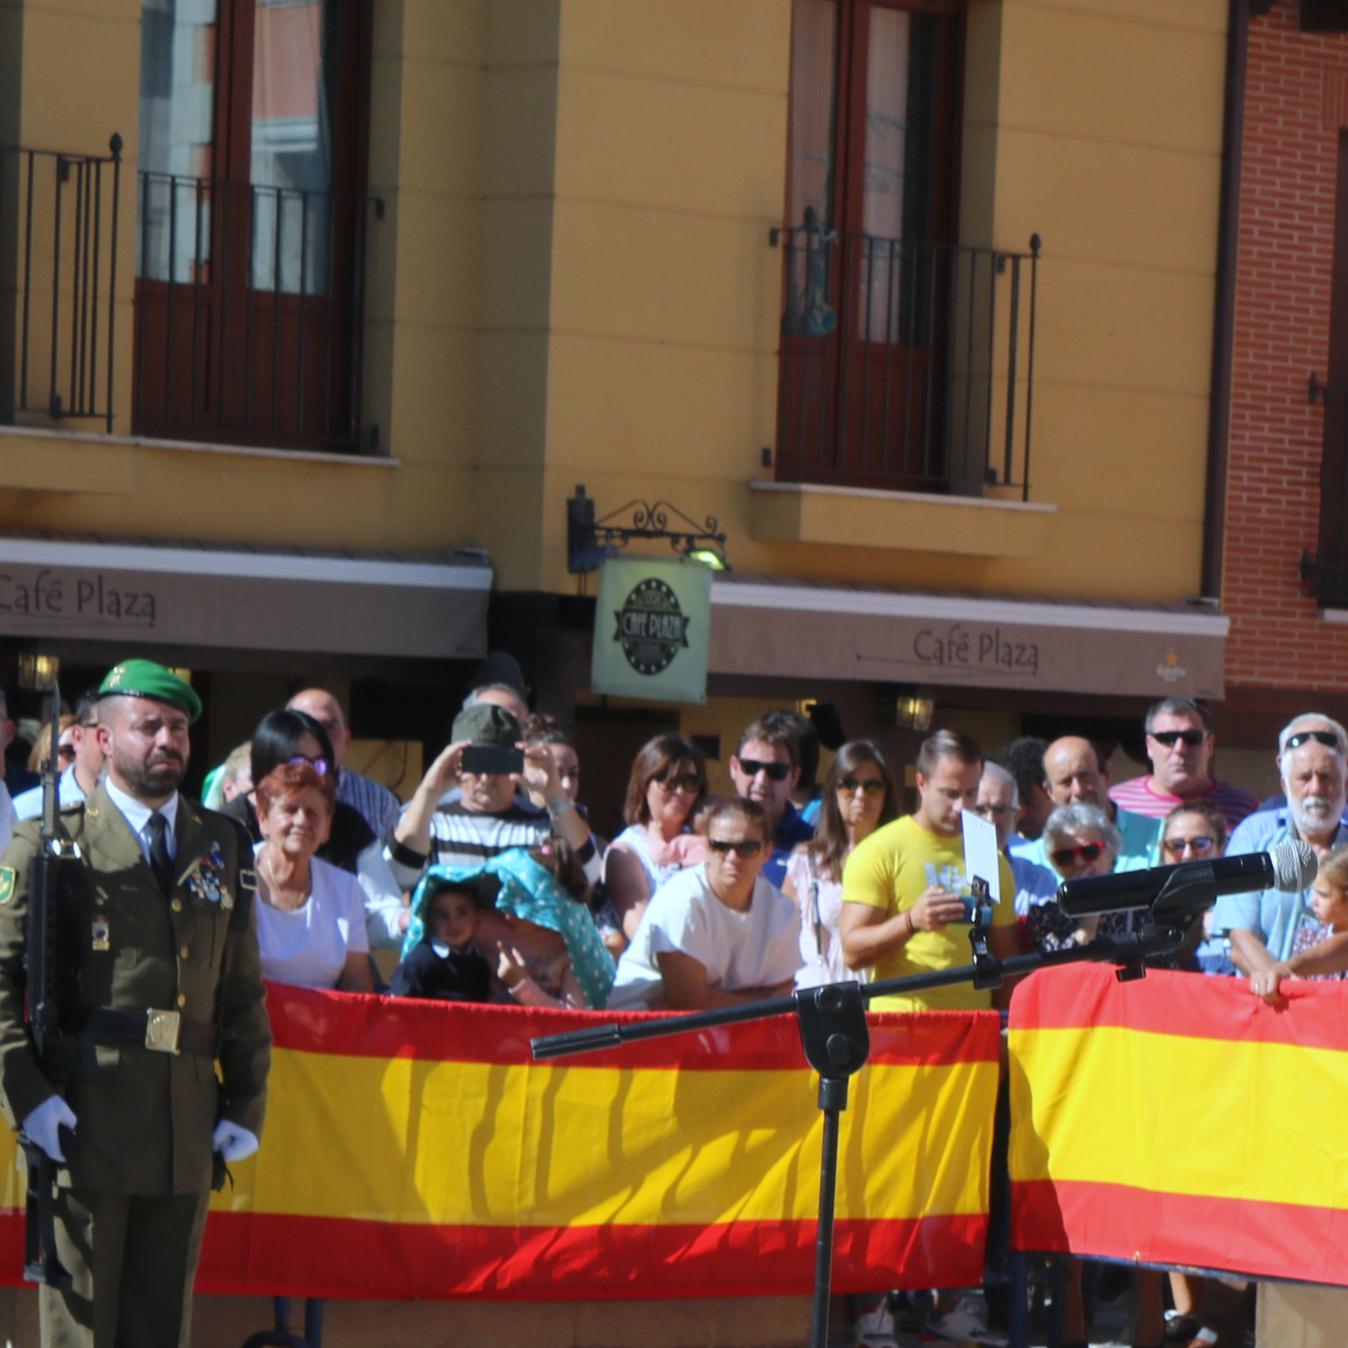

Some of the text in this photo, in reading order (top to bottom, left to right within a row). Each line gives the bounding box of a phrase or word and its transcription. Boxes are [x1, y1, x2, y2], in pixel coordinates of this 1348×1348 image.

[77, 573, 156, 628] Plaza
[913, 623, 1039, 676] Café Plaza
